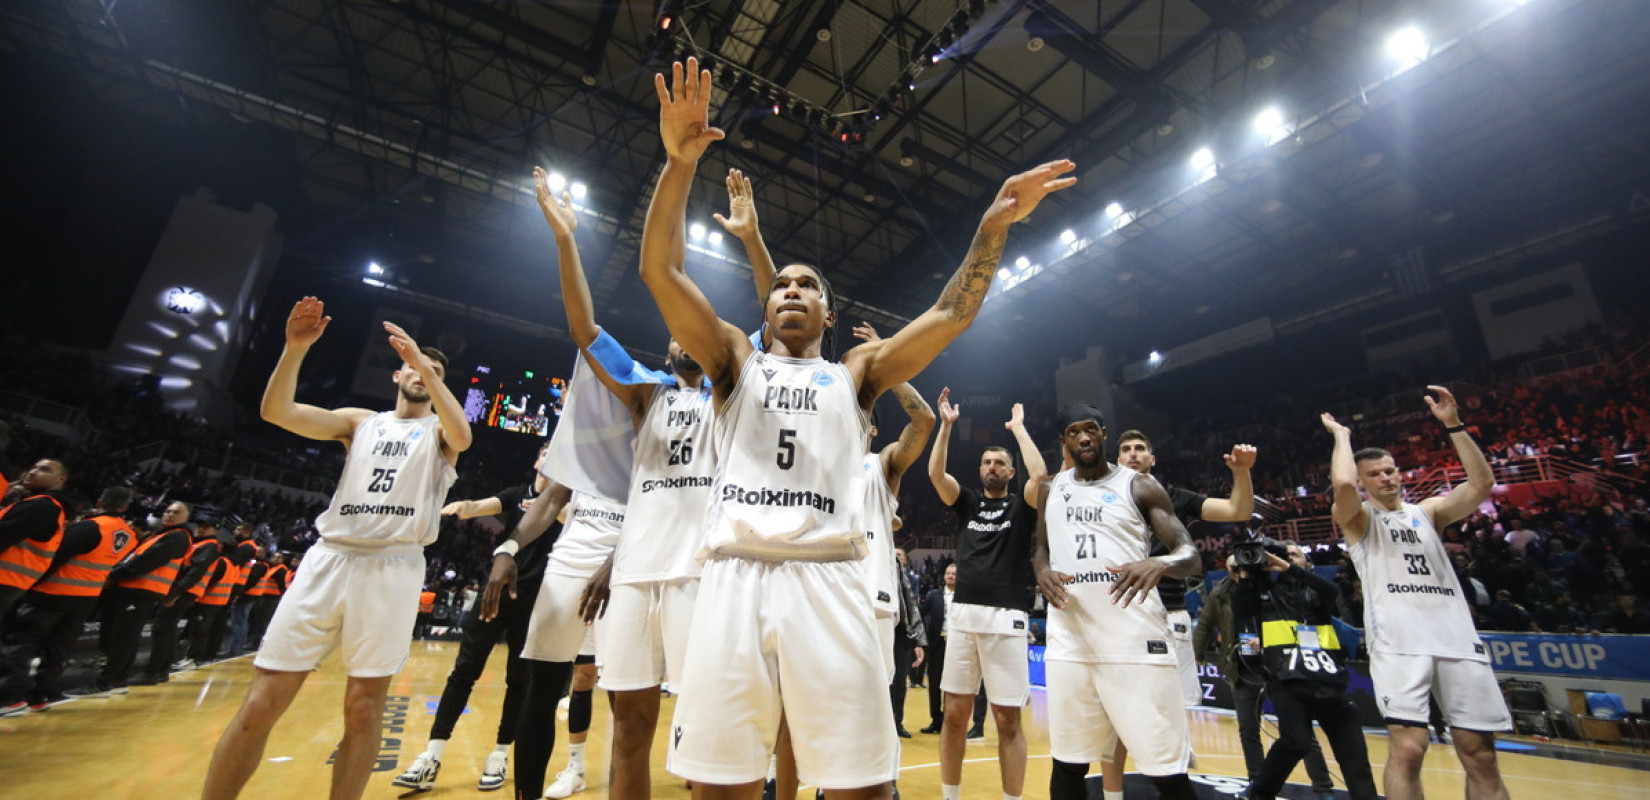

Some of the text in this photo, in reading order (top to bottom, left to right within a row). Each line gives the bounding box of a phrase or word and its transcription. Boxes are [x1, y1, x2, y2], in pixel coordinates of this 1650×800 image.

[763, 384, 818, 411] PAOK
[668, 437, 693, 466] 26
[776, 429, 797, 470] 5
[368, 468, 397, 493] 25
[340, 502, 415, 516] Stoiximan
[722, 484, 835, 514] Stoiximan
[1075, 533, 1097, 560] 21
[1404, 553, 1431, 576] 33
[1283, 648, 1338, 674] 759
[1539, 642, 1606, 670] CUP
